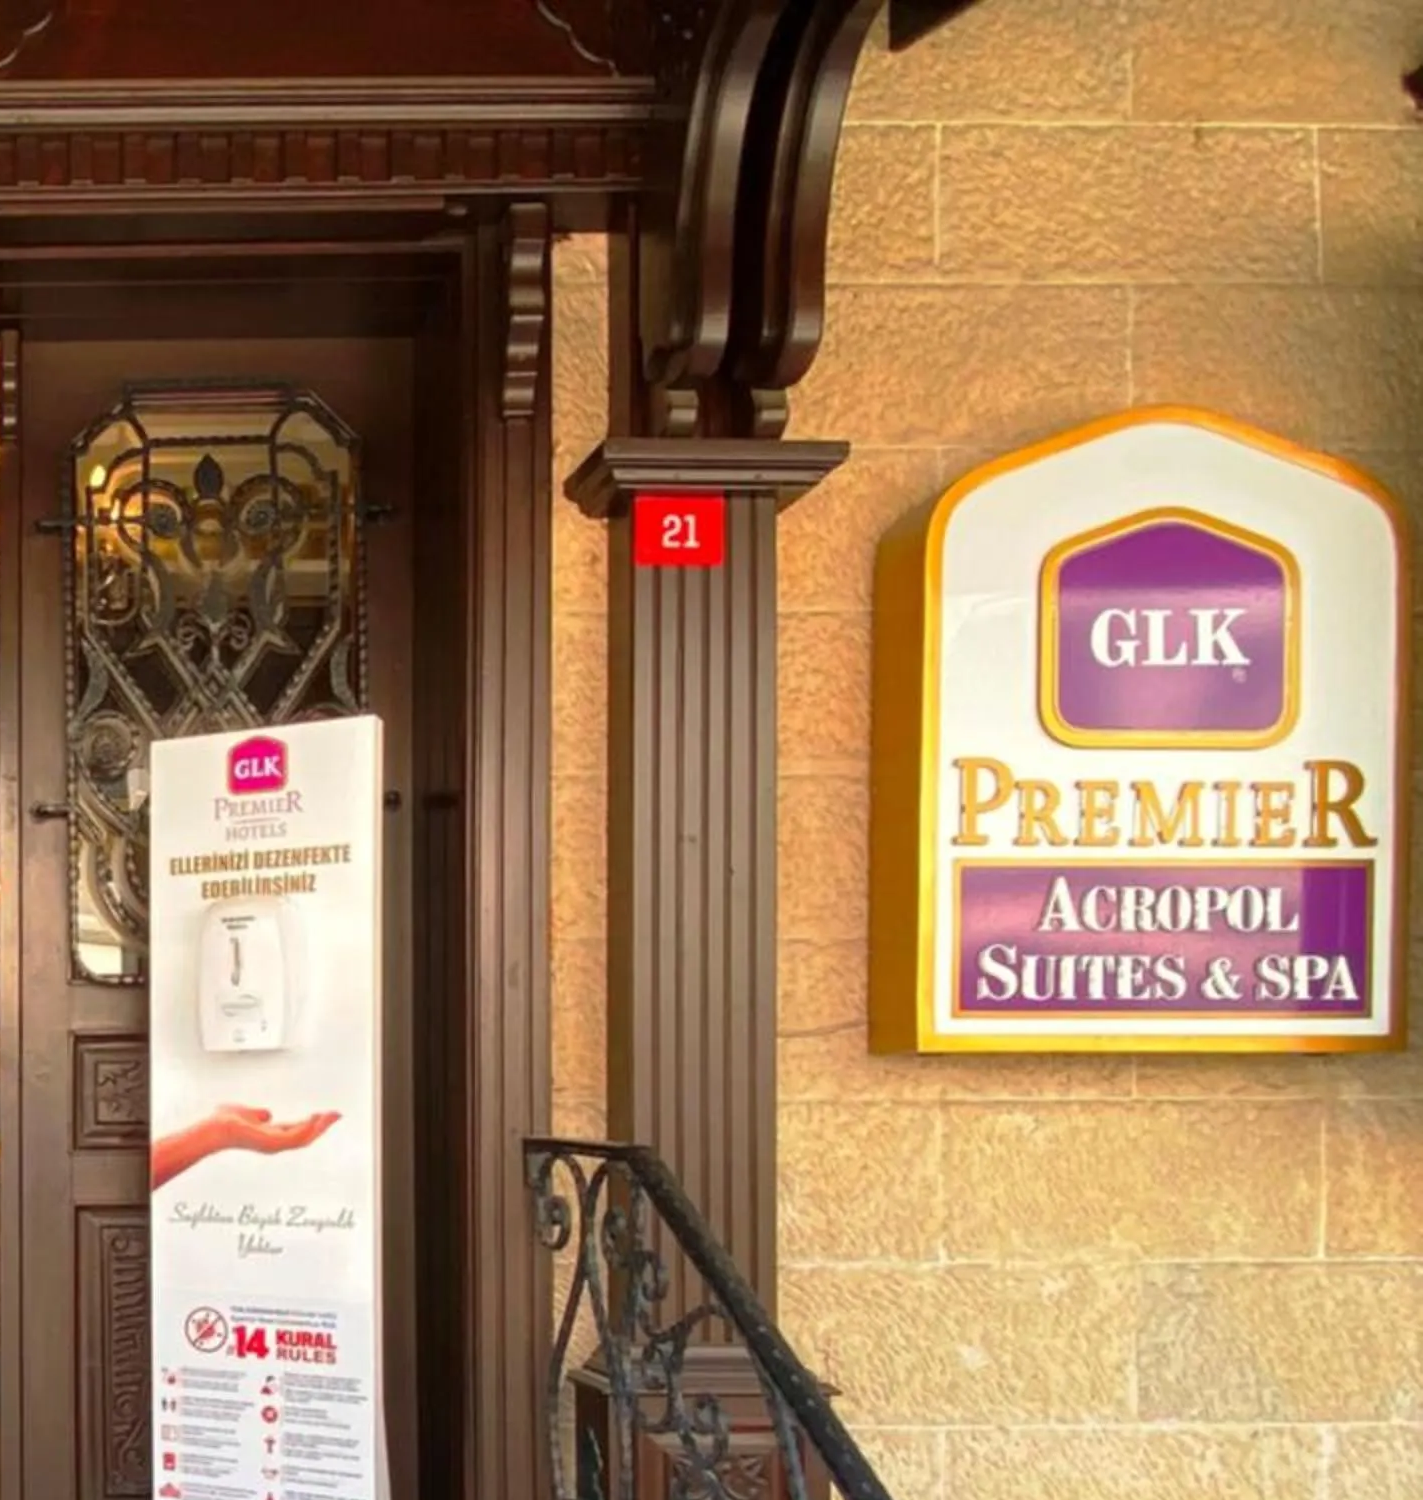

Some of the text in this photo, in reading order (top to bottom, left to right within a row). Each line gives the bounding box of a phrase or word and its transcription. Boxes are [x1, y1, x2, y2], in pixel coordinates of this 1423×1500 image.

[661, 513, 701, 549] 21
[1089, 606, 1251, 668] GLK
[234, 755, 283, 780] GLK
[213, 789, 303, 821] PREMIER
[951, 756, 1378, 849] PREMIER
[225, 822, 288, 841] HOTELS
[169, 844, 352, 876] ELLERİNİZİ DEZENFEKTE
[1037, 876, 1300, 934] ACROPOL
[976, 943, 1359, 1002] SUITES & SPA
[232, 1325, 270, 1359] 14
[276, 1328, 337, 1350] KURAL
[276, 1347, 337, 1365] RULES
